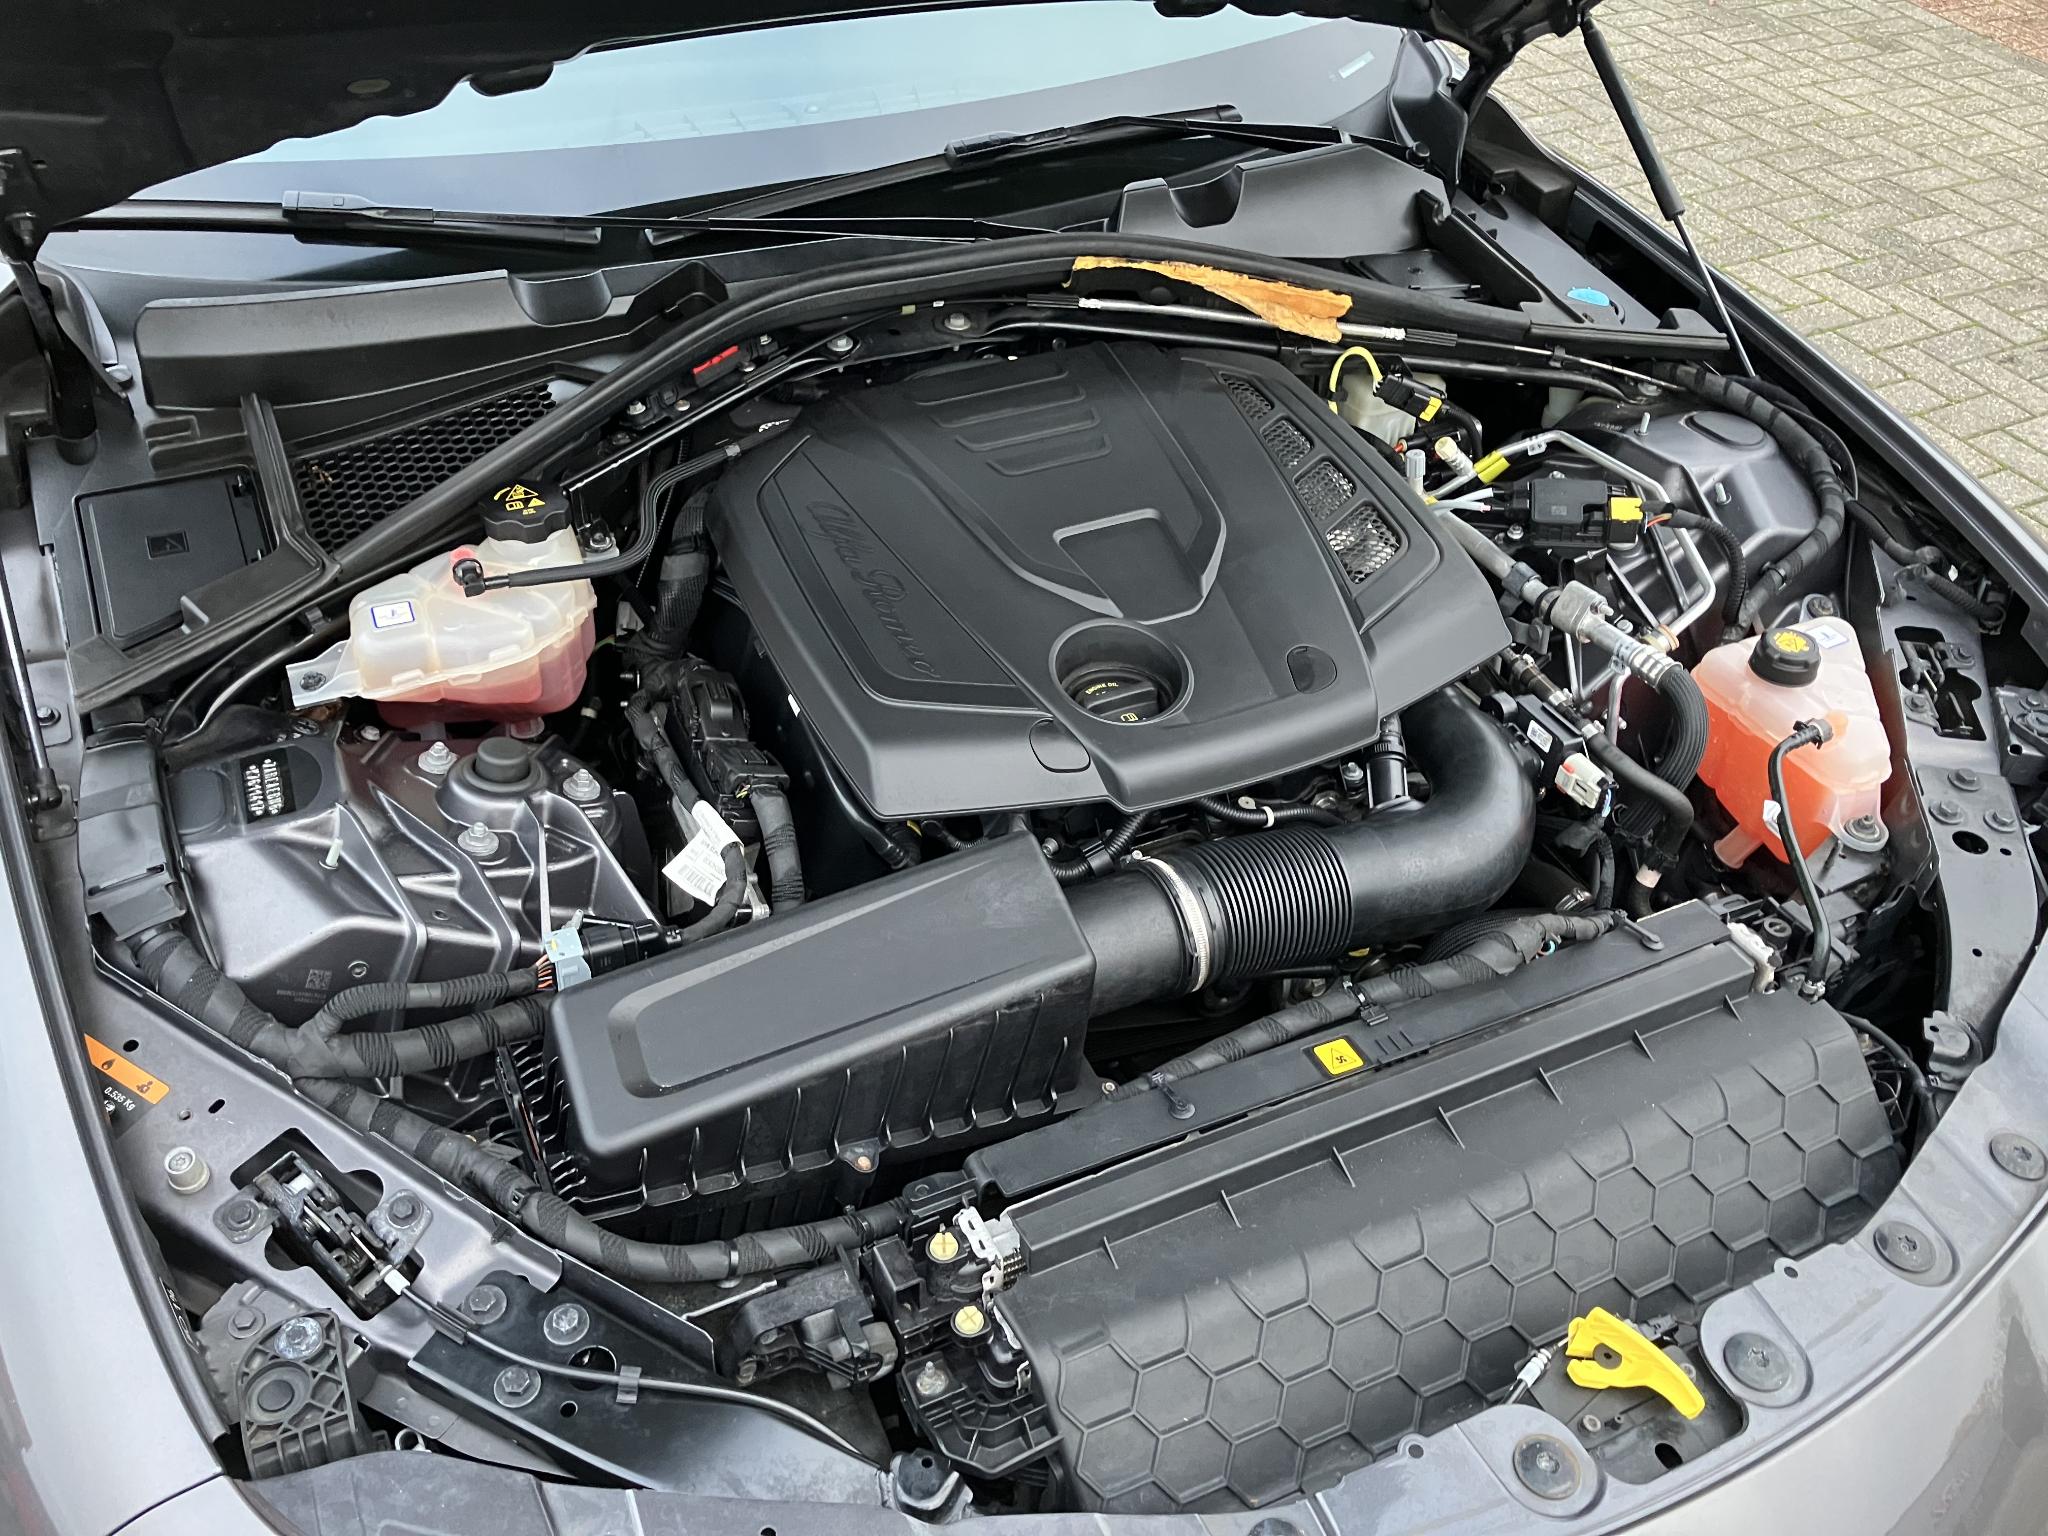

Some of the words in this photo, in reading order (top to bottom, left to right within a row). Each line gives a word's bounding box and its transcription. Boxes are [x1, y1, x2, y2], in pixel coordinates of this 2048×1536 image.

[801, 501, 875, 569] Alfa
[851, 569, 941, 678] Romeo
[104, 1086, 126, 1103] 0.535
[123, 1098, 136, 1111] Kg
